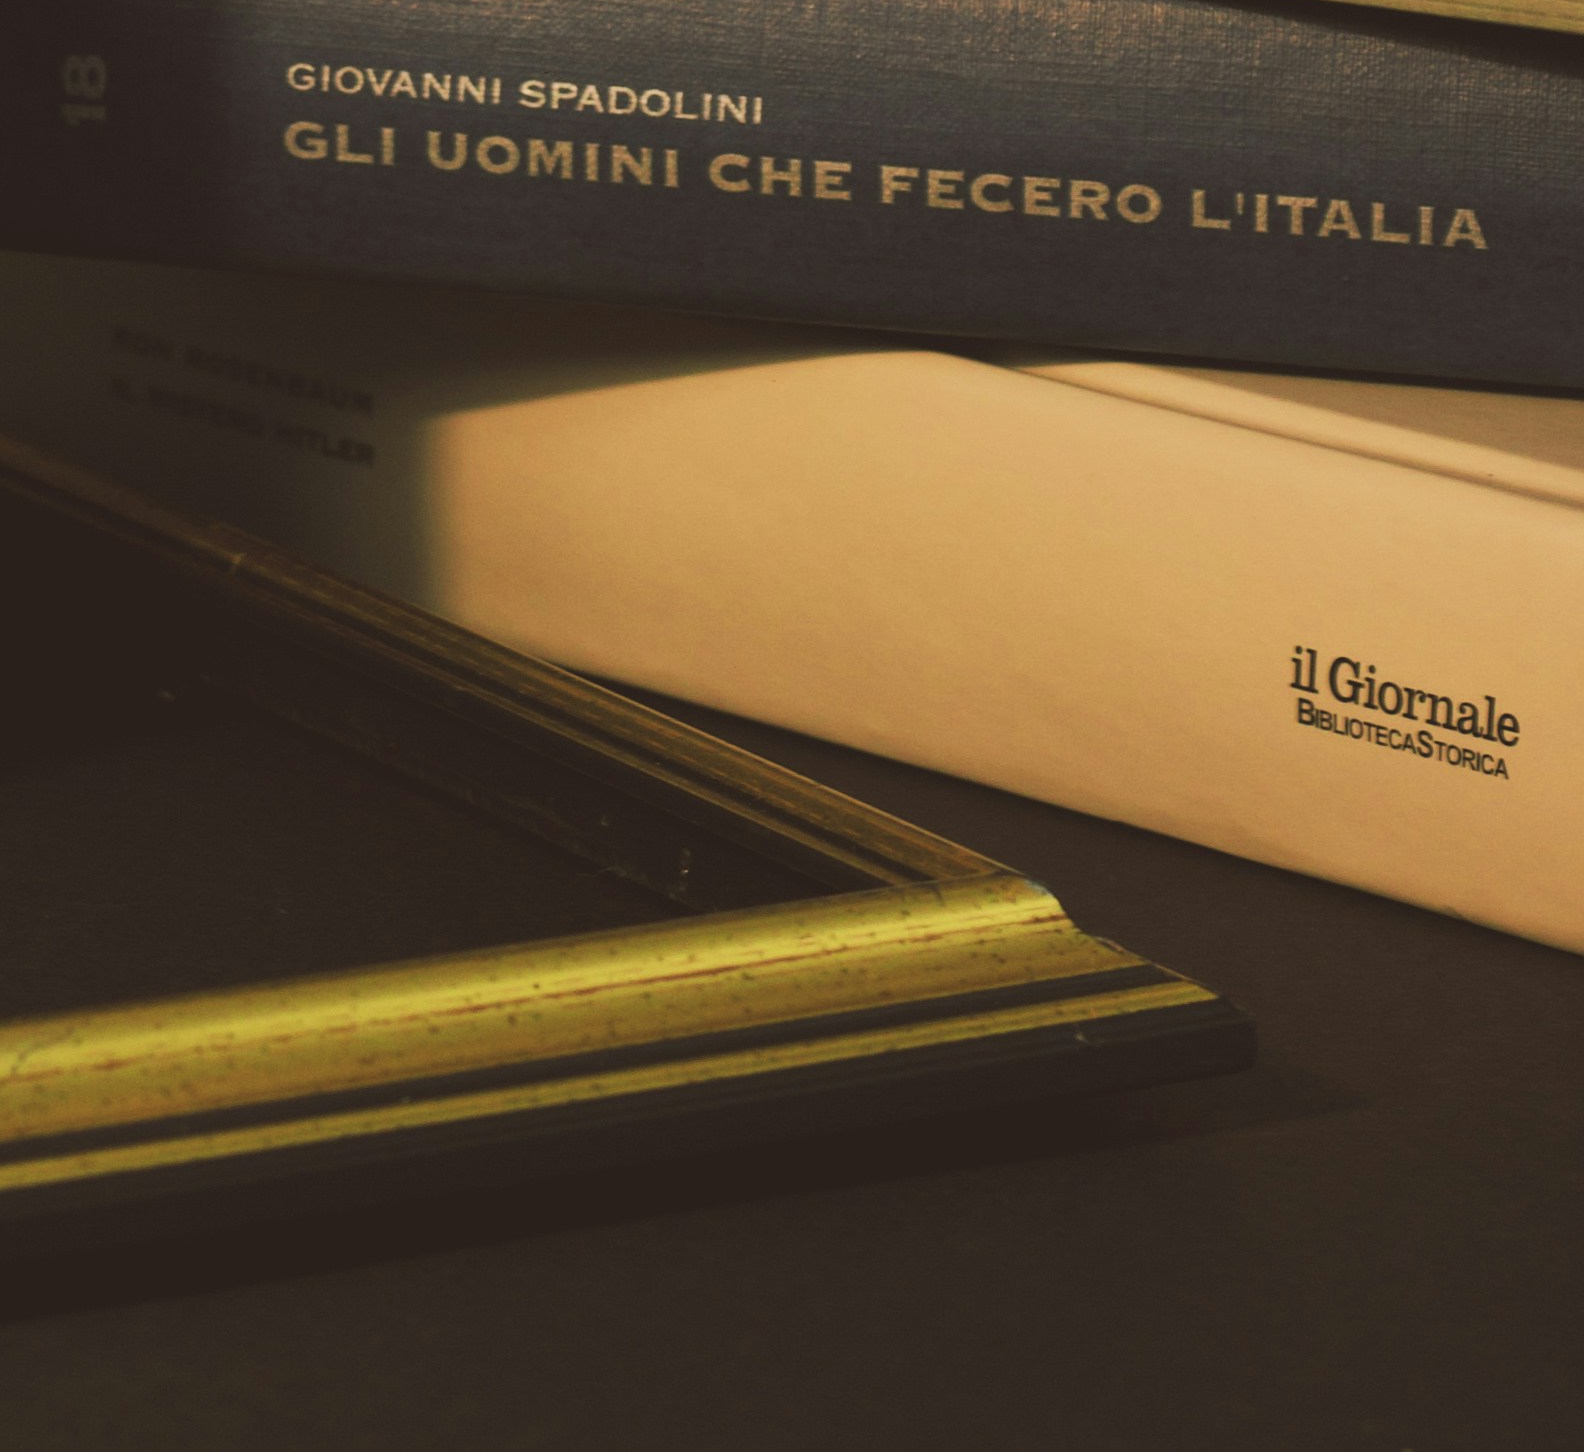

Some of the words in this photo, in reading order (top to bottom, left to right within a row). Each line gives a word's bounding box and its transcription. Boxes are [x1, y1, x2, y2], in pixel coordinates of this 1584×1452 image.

[61, 52, 108, 126] 18
[285, 61, 502, 106] GIOVANNI
[518, 78, 764, 125] SPADOLINI
[283, 119, 397, 167] GLI
[427, 129, 680, 189] UOMINI
[708, 152, 853, 202] CHE
[879, 163, 1164, 225] FECERO
[1190, 188, 1490, 250] L'ITALIA
[1289, 644, 1319, 695] il
[1328, 656, 1521, 748] Giornale
